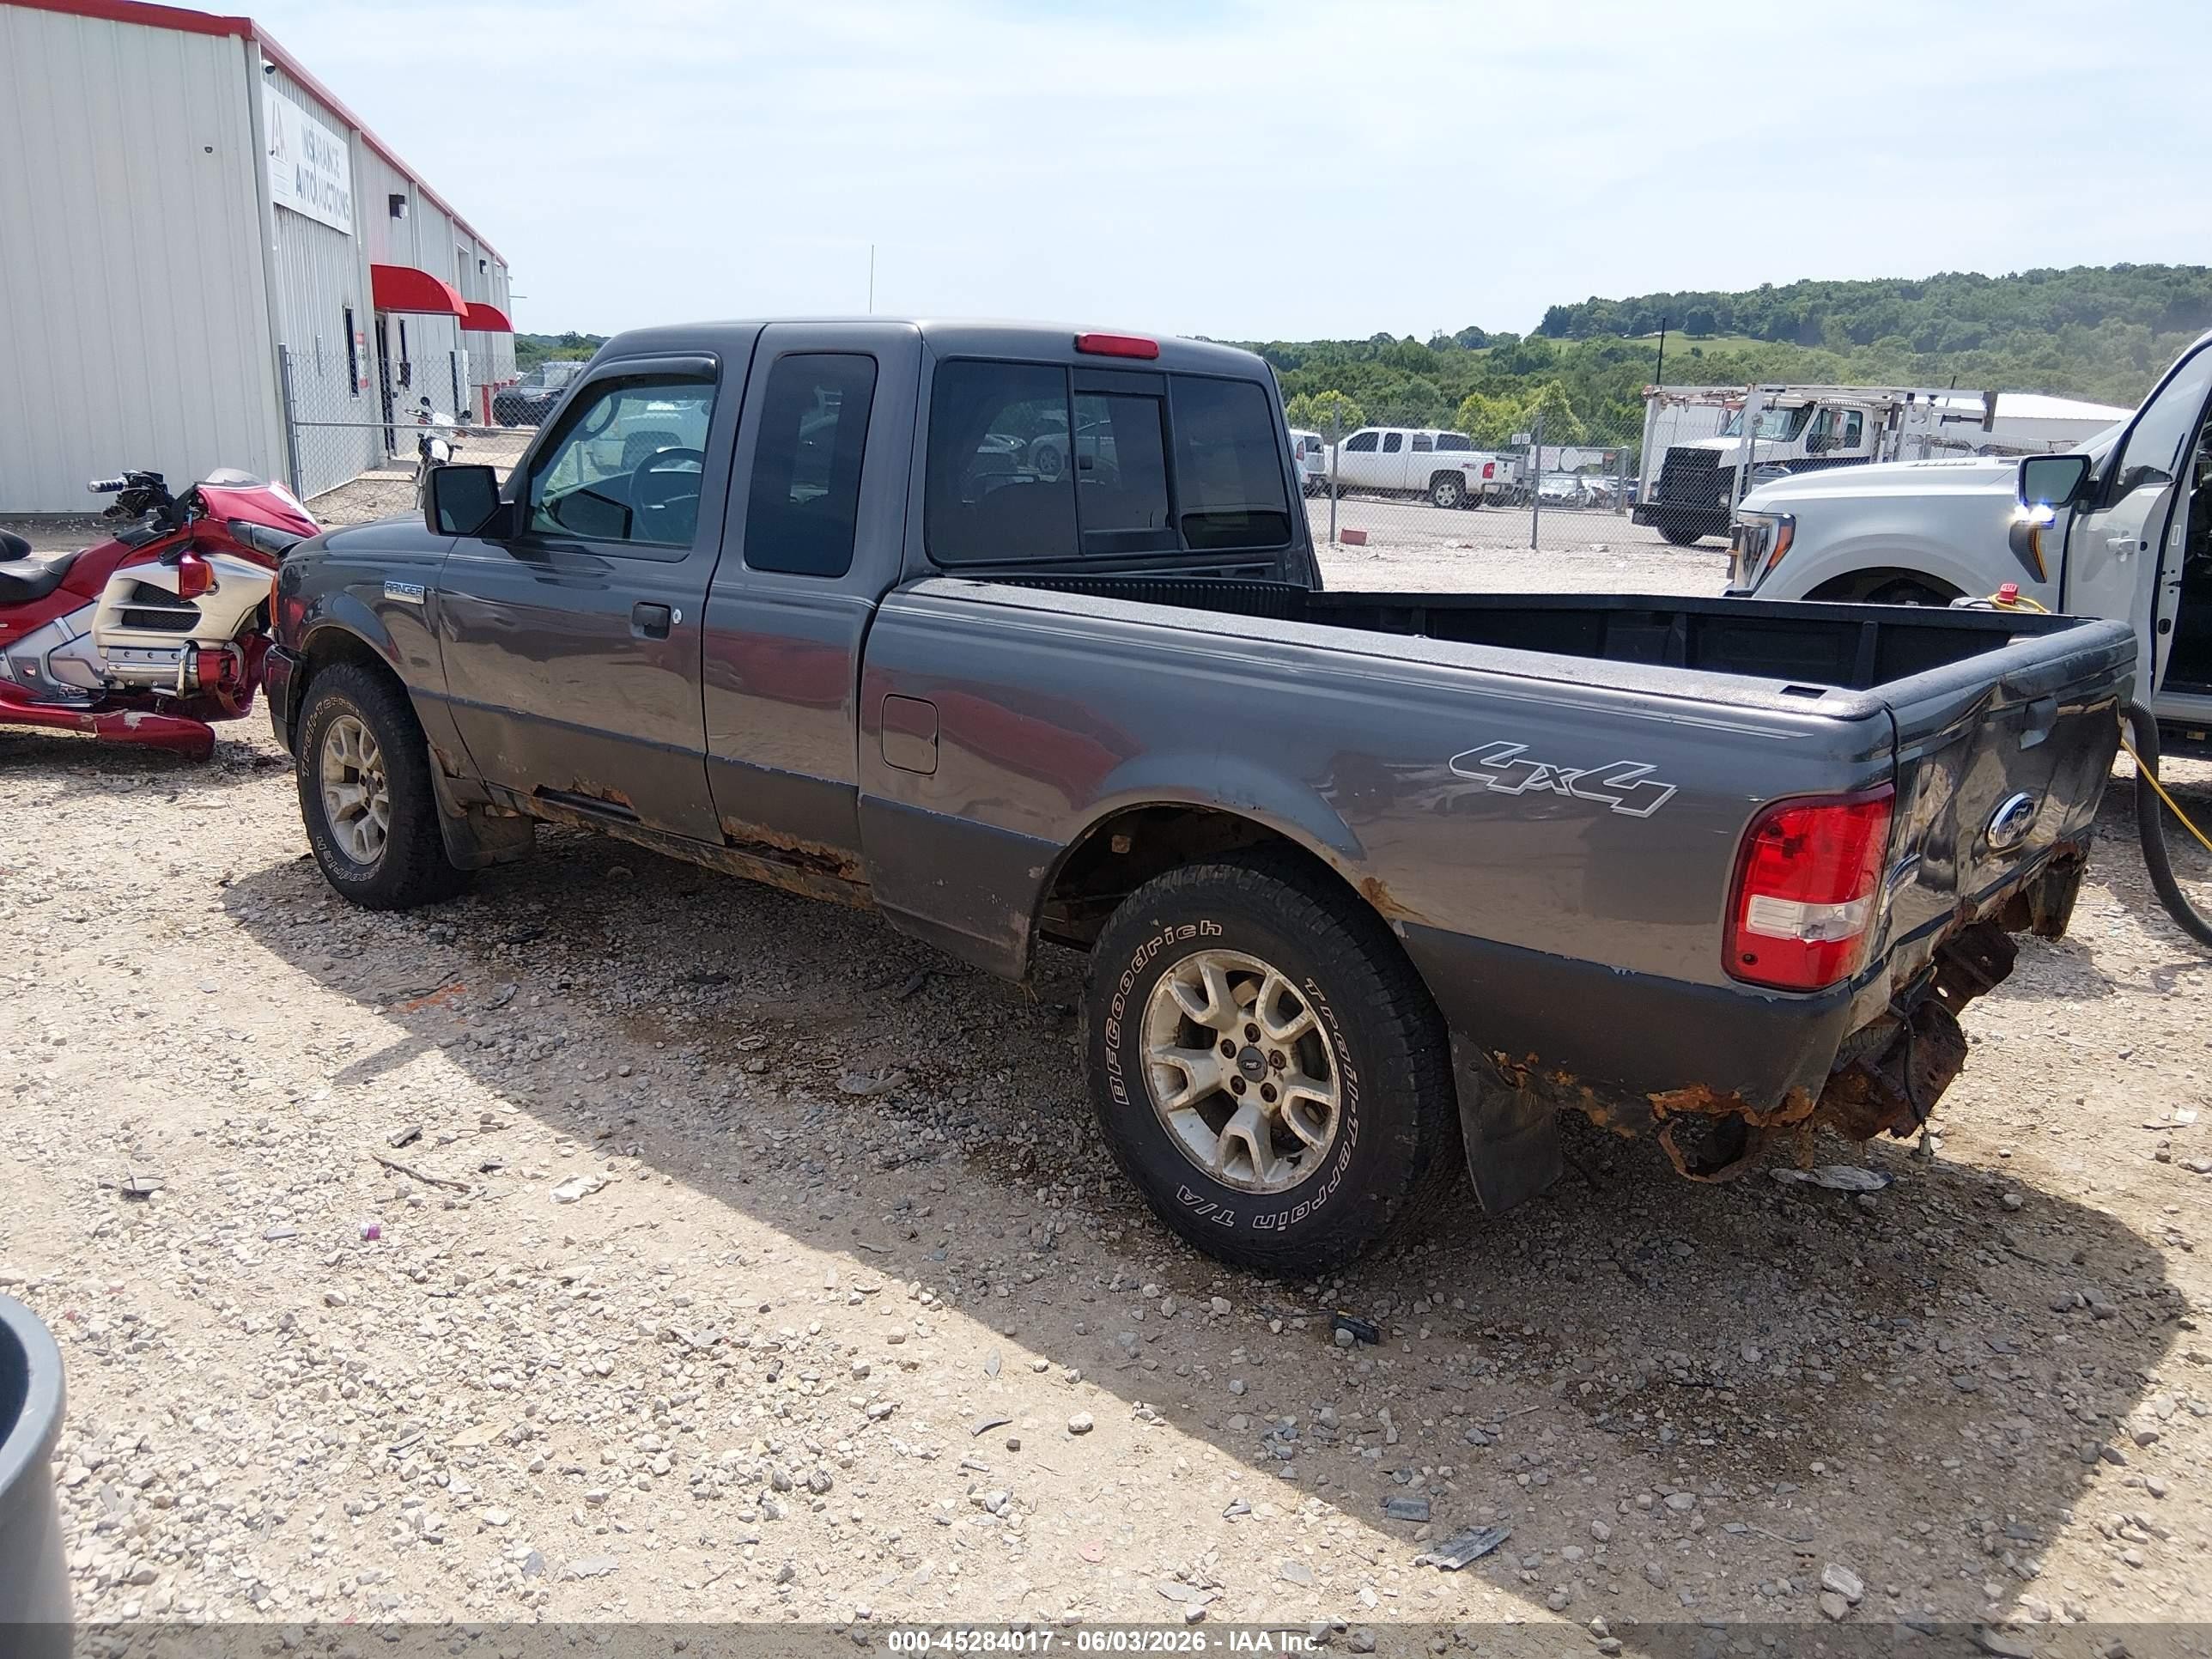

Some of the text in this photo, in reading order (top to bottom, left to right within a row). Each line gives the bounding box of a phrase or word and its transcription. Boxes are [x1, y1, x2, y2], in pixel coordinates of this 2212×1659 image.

[386, 583, 422, 596] RANGER
[1106, 920, 1223, 1106] BFGoodrich
[1176, 977, 1359, 1231] Trail-Terrain T/A
